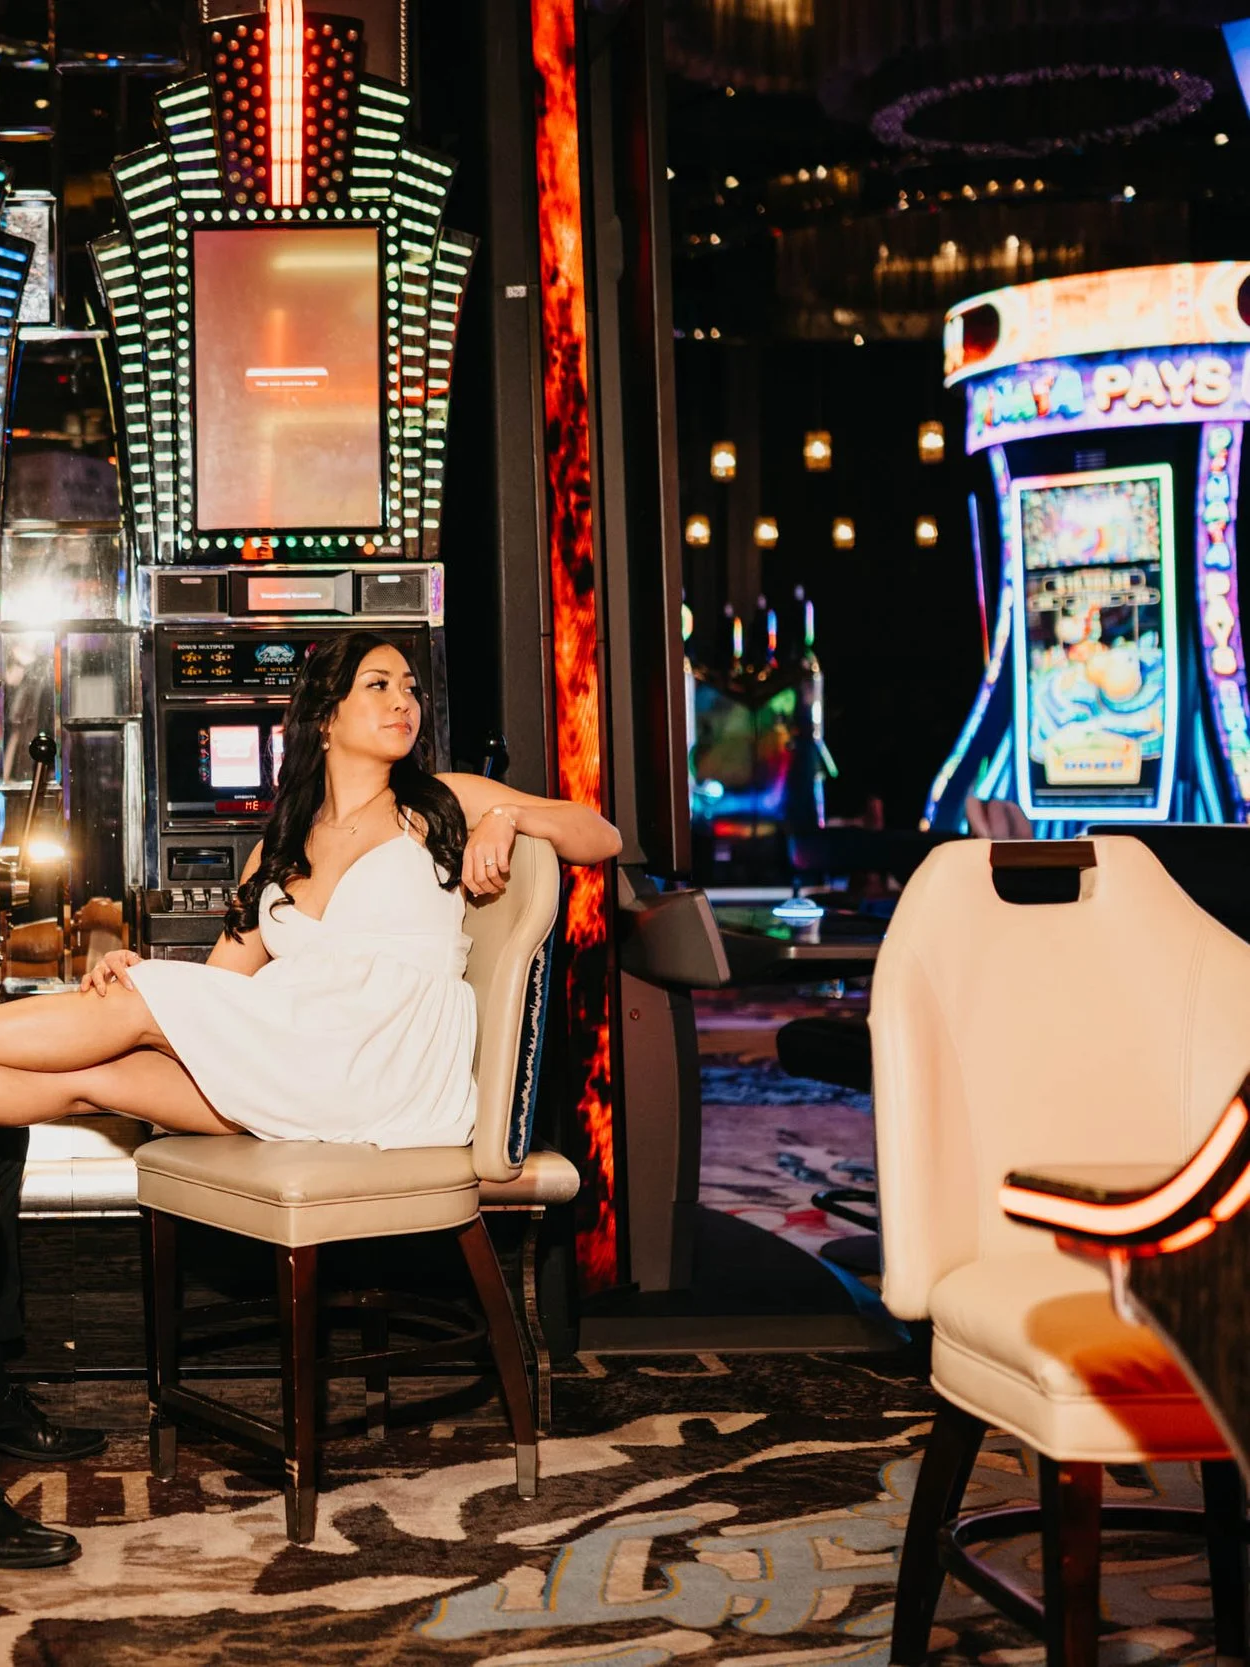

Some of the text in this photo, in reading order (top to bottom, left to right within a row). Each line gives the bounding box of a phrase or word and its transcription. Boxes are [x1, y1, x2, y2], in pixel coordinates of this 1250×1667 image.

[1094, 356, 1232, 412] PAYS
[259, 652, 294, 664] Jackpot
[245, 800, 259, 811] ME
